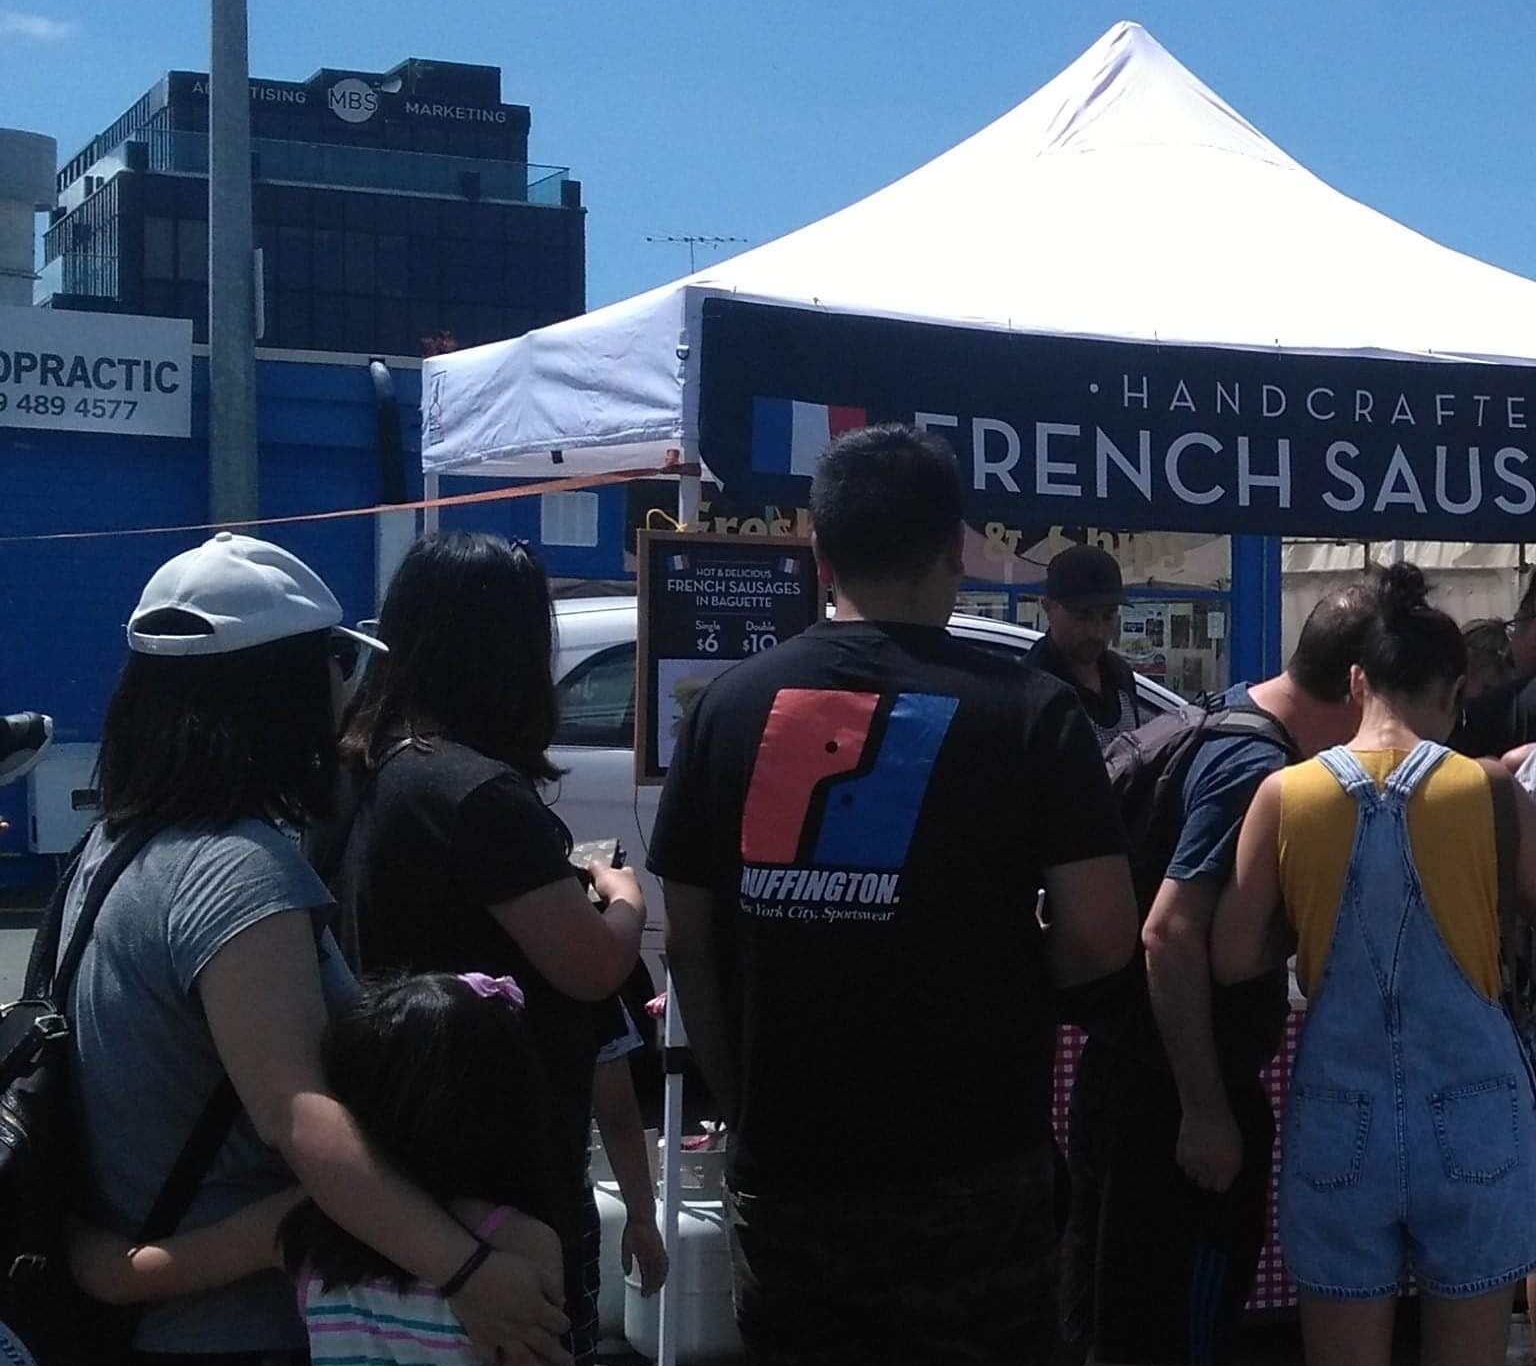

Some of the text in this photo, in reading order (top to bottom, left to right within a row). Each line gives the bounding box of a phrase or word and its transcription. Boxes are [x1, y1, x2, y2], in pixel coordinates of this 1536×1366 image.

[192, 82, 306, 103] ATISING
[328, 87, 378, 111] MBS
[405, 101, 507, 123] MARKETING
[16, 393, 66, 416] 489
[74, 397, 138, 420] 4577
[696, 567, 715, 577] HOT
[725, 569, 773, 579] DELICIOUS
[667, 579, 801, 595] FRENCH SAUSAGES
[696, 596, 773, 608] IN BAGUETTE
[696, 633, 719, 653] $6
[755, 902, 784, 918] York
[822, 906, 895, 925] Sportswear
